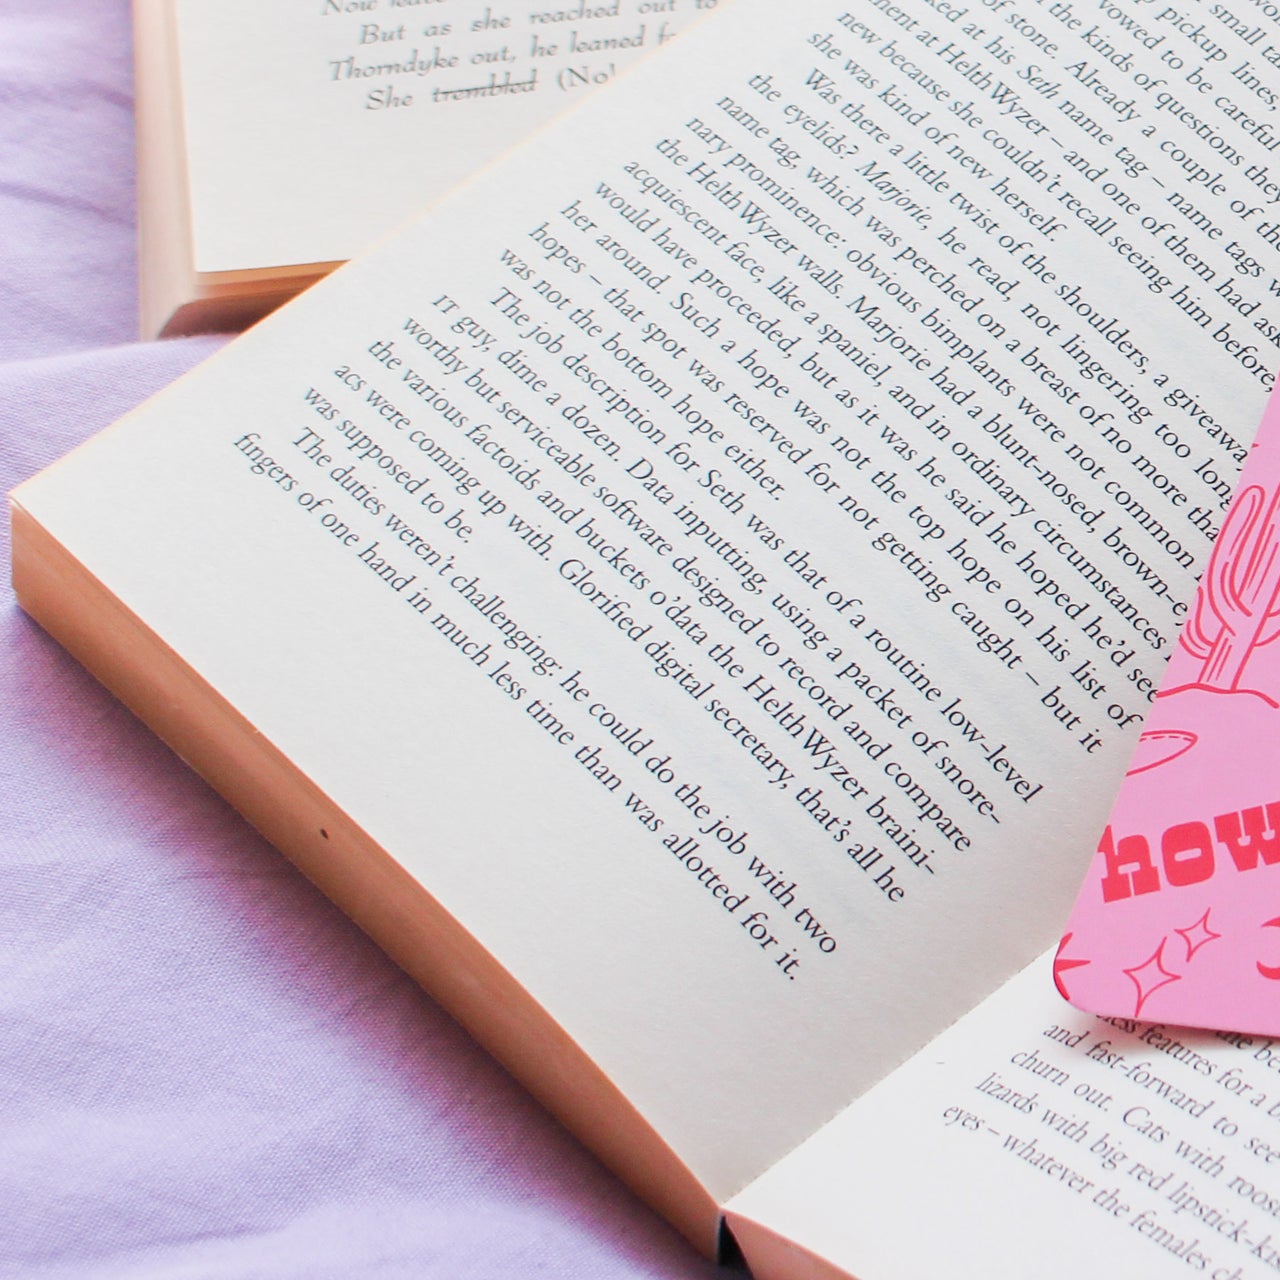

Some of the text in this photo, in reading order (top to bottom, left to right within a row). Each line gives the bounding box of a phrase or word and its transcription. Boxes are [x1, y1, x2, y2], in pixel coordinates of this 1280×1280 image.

[232, 431, 800, 981] fingers of one hand in much less time than was allotted for it.
[303, 386, 473, 544] was supposed to be.
[488, 285, 1044, 804] The job description for Seth was that of a routine low-level
